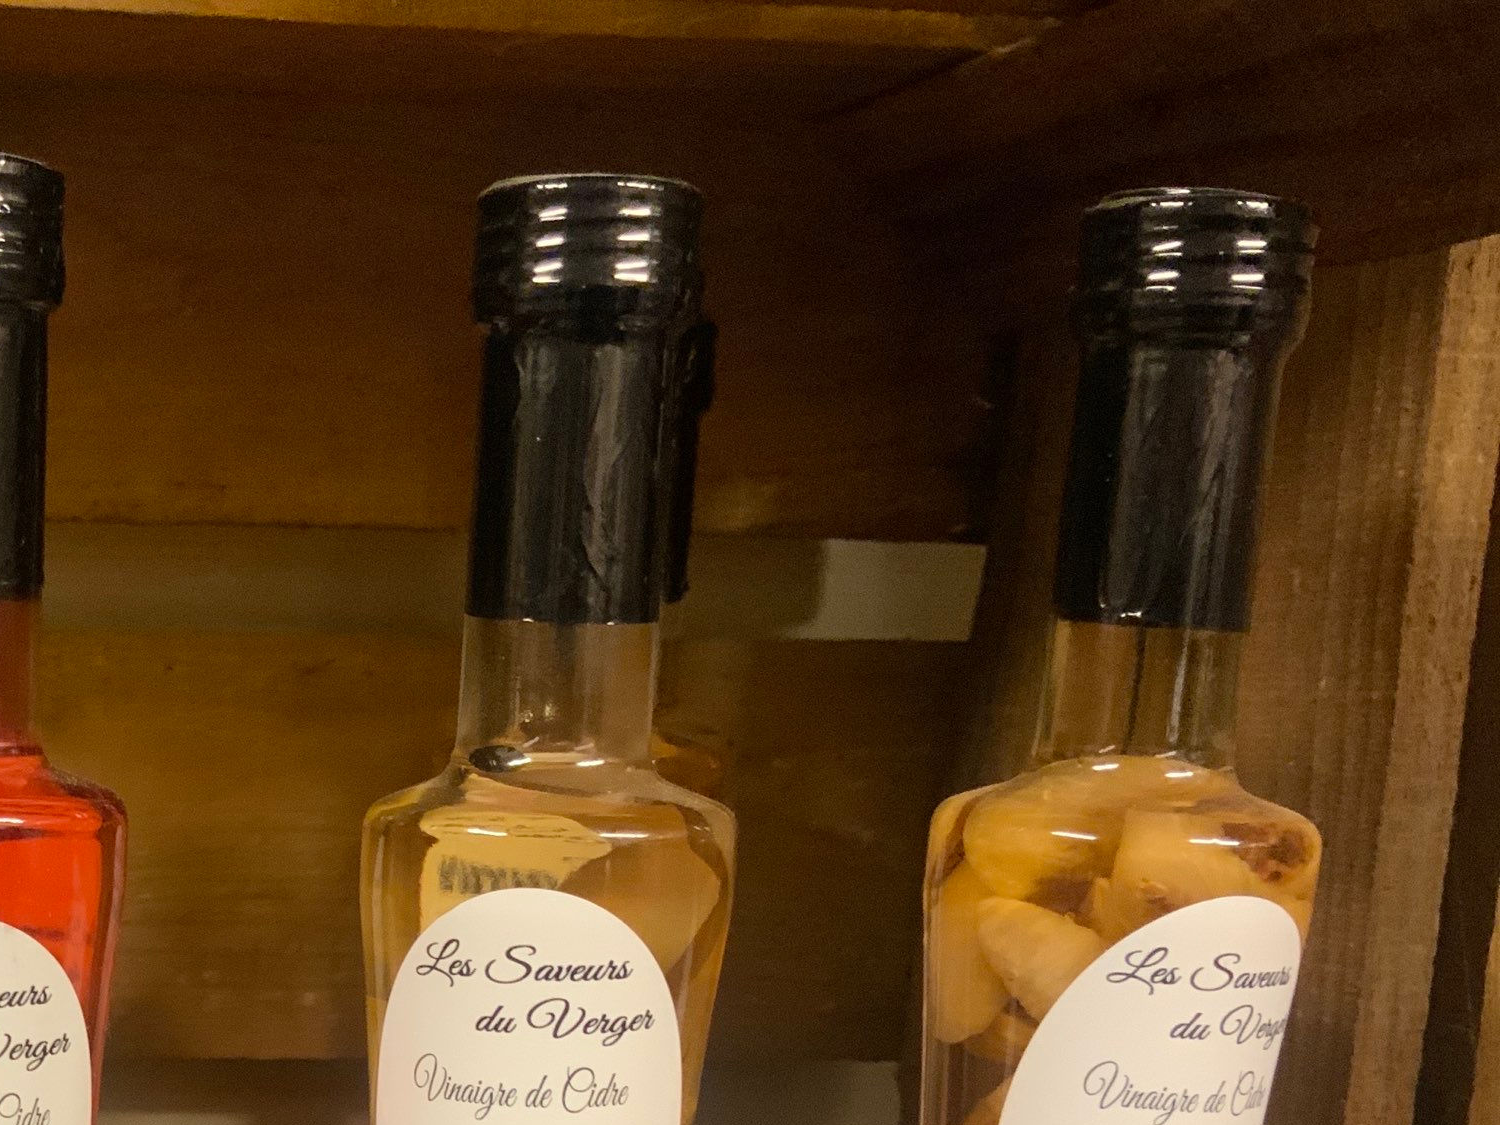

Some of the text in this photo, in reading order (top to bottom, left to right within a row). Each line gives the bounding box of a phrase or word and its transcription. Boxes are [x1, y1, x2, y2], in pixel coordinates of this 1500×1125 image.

[416, 938, 632, 986] Les Saveurs
[1106, 947, 1292, 994] Les Saveurs
[475, 997, 654, 1047] du Verger
[1170, 1012, 1210, 1040] du
[414, 1053, 629, 1120] Vinaigre de Cidre
[1083, 1060, 1198, 1125] Vinaigre
[1204, 1080, 1226, 1113] de
